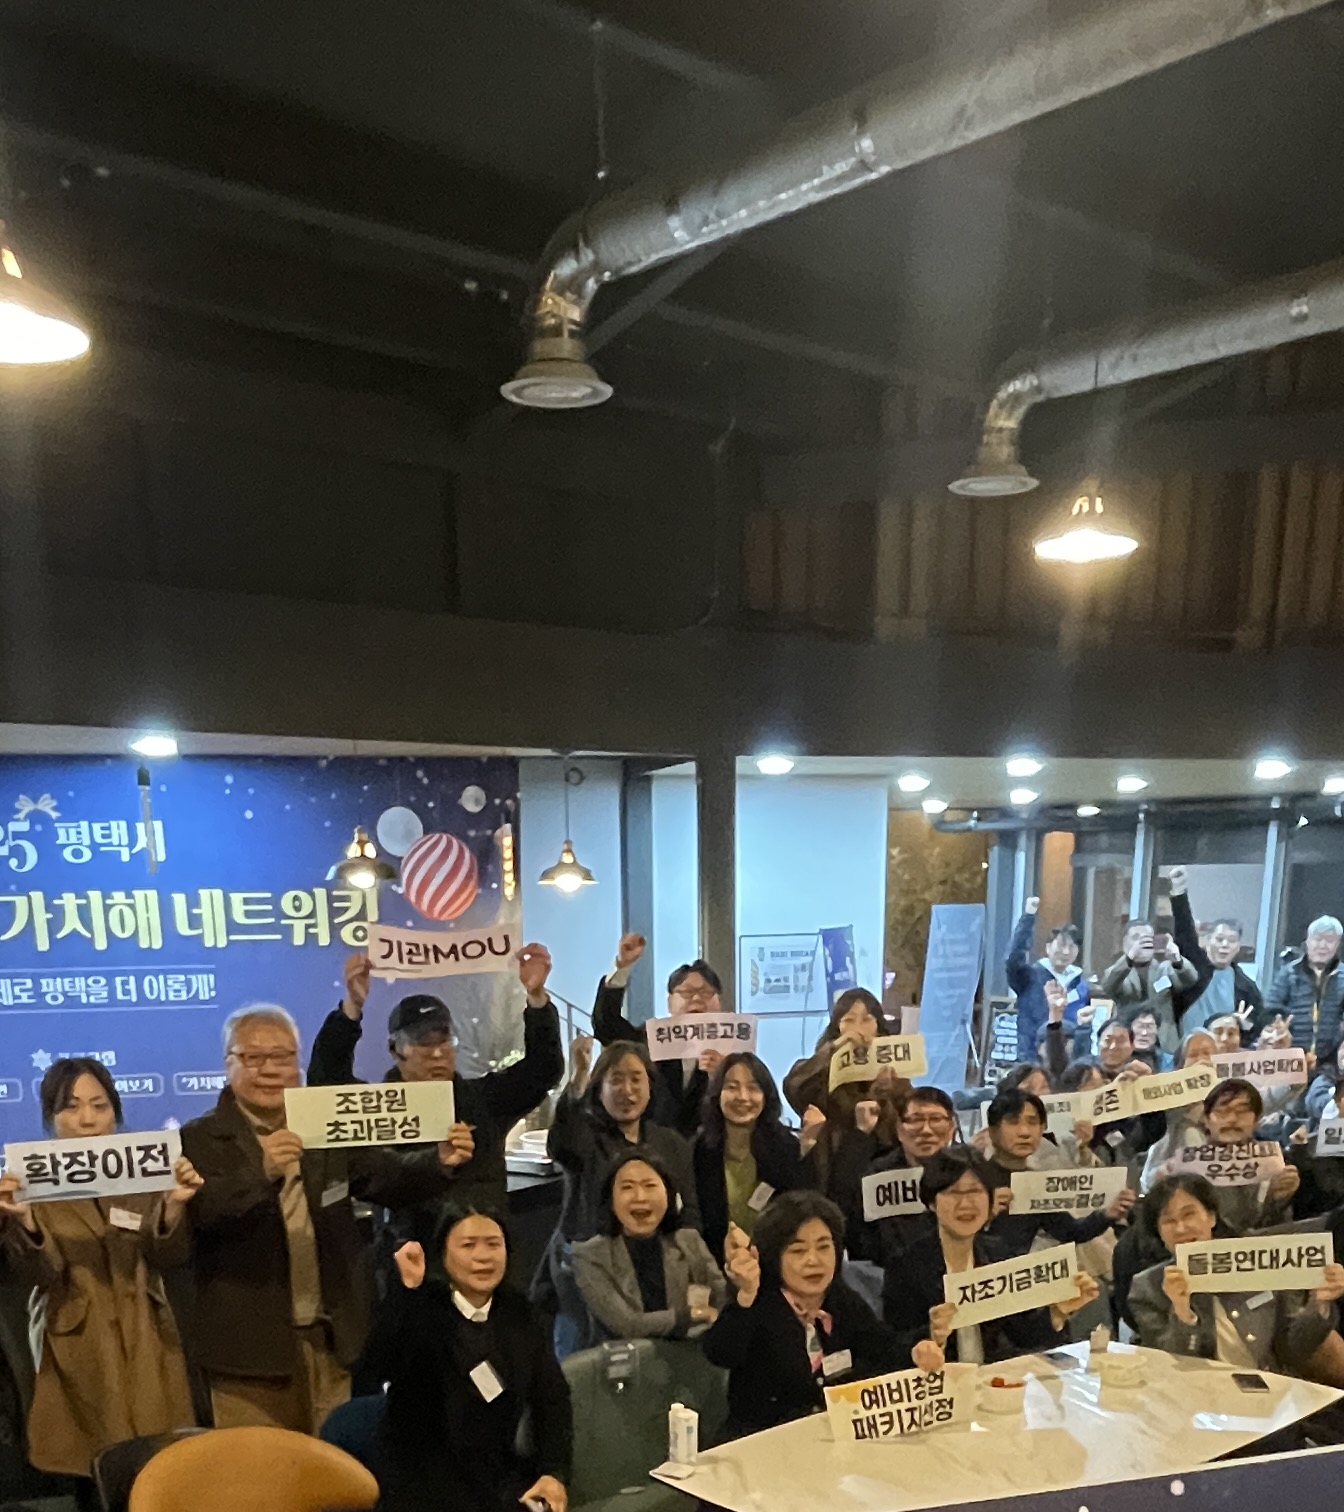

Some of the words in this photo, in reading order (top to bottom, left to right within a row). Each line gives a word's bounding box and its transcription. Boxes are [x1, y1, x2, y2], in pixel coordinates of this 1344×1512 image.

[55, 819, 167, 867] 평택시
[0, 888, 163, 951] 가치해
[176, 885, 379, 948] 네트워킹
[378, 934, 513, 965] 기관MOU
[39, 976, 110, 1004] 평택을
[115, 975, 138, 1002] 더
[655, 1022, 752, 1042] 취약계층고용
[838, 1047, 871, 1070] 고용
[876, 1042, 912, 1063] 증대
[335, 1088, 408, 1116] 조합원
[325, 1116, 422, 1144] 초과달성
[22, 1142, 173, 1186] 확장이전
[1205, 1161, 1260, 1181] 우수상
[1045, 1174, 1094, 1193] 장애인
[957, 1258, 1070, 1307] 자조기금확대
[859, 1371, 946, 1410] 예비창업
